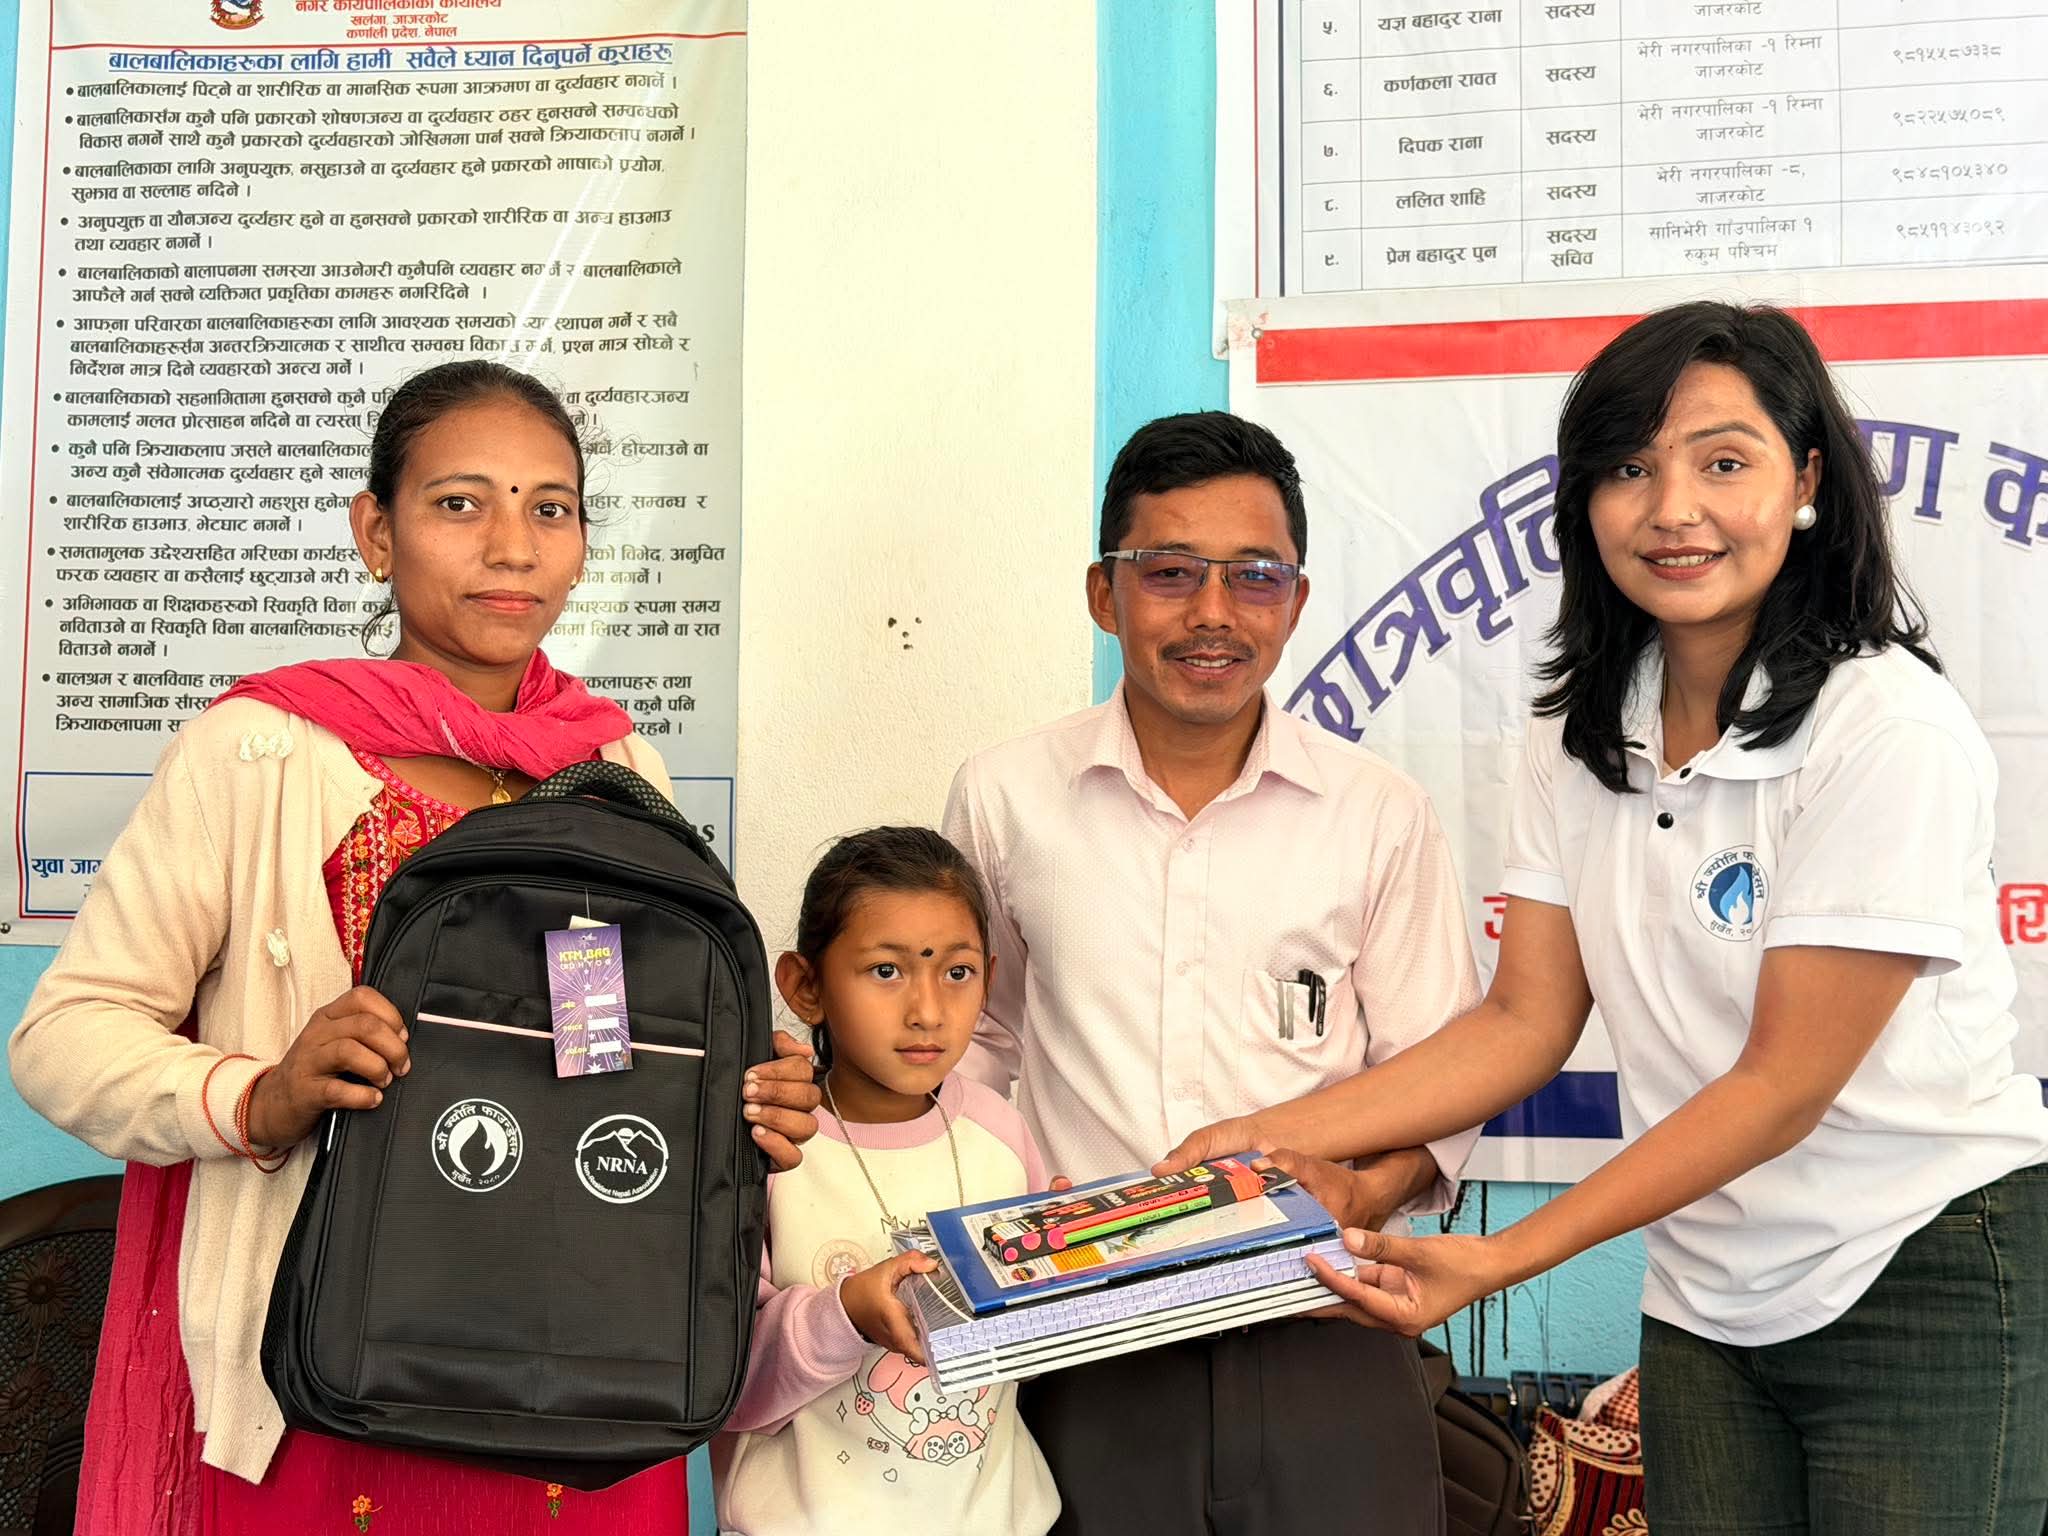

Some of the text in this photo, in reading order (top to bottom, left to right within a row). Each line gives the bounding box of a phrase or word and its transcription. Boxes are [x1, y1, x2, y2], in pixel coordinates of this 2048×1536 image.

[393, 11, 448, 24] जाजरकोट
[1377, 17, 1407, 31] यज्ञ
[1412, 12, 1462, 29] बहादुर
[1467, 9, 1503, 24] राना
[1544, 3, 1596, 20] सदस्य
[1693, 0, 1763, 16] जाजरकोट
[346, 26, 387, 38] कर्णाली
[425, 25, 457, 37] नेपाल
[291, 49, 339, 69] लागि
[347, 49, 392, 69] हामी
[523, 43, 592, 71] दिनुपर्ने
[1637, 41, 1663, 58] भेरी
[1671, 36, 1752, 57] नगरपालिका
[1384, 75, 1453, 92] कर्णकला
[1457, 72, 1498, 87] रावत
[1545, 66, 1597, 82] सदस्य
[1694, 60, 1764, 78] जाजरकोट
[257, 80, 411, 97] शारीरिक मानसिक
[186, 108, 317, 127] कुनै पनि प्रकारको
[1637, 104, 1662, 120] भेरी
[1672, 98, 1753, 118] नगरपालिका
[80, 125, 685, 150] विकास नगर्ने कुनै प्रकारको जोखिममा नगर्ने
[1399, 137, 1444, 154] दिपक
[1448, 136, 1484, 151] राना
[1545, 129, 1597, 145] सदस्य
[1696, 122, 1765, 141] जाजरकोट
[177, 155, 552, 179] लागि नसुहाउने हुने प्रकारको
[1657, 166, 1682, 183] भेरी
[1690, 162, 1772, 181] नगरपालिका
[140, 180, 240, 199] सल्लाह नदिने
[1395, 191, 1445, 209] ललित
[1450, 188, 1487, 206] शाहि
[1546, 184, 1597, 200] सदस्य
[1696, 185, 1766, 204] जाजरकोट
[300, 207, 672, 229] हुने प्रकारको शारीरिक हाउभाउ
[75, 232, 201, 252] तथा व्यवहार नगर्ने
[1386, 247, 1411, 265] प्रेम
[1416, 247, 1467, 264] बहादुर
[1472, 245, 1498, 263] पुन
[1546, 228, 1598, 244] सदस्य
[1550, 249, 1594, 267] सचिव
[78, 257, 682, 280] बालबालिकाको बालापनमा समस्या आउनेगरी कुनैपनि व्यवहार बालबालिकाले
[399, 282, 470, 300] नगरिदिने
[134, 312, 632, 332] परिवारका लागि आवश्यक गर्ने
[70, 358, 352, 377] निर्देशन दिने व्यवहारको गर्ने
[65, 387, 366, 408] बालबालिकाको सहभागितामा कुनै
[67, 411, 290, 429] कामलाई गलत नदिने
[68, 439, 272, 459] कुनै पनि जसले
[71, 462, 324, 483] अन्य कुनै हुने
[64, 513, 291, 531] शारीरिक भेटघाट नगर्ने
[56, 568, 350, 584] फरक व्यवहार गरी
[63, 594, 721, 614] अभिभावक समय
[637, 620, 720, 636] जाने रात
[117, 640, 156, 656] नगर्ने
[663, 676, 692, 689] तथा
[56, 692, 696, 715] अन्य सामाजिक कुनै पनि
[445, 1104, 476, 1128] ज्योति
[597, 1156, 648, 1174] NRNA
